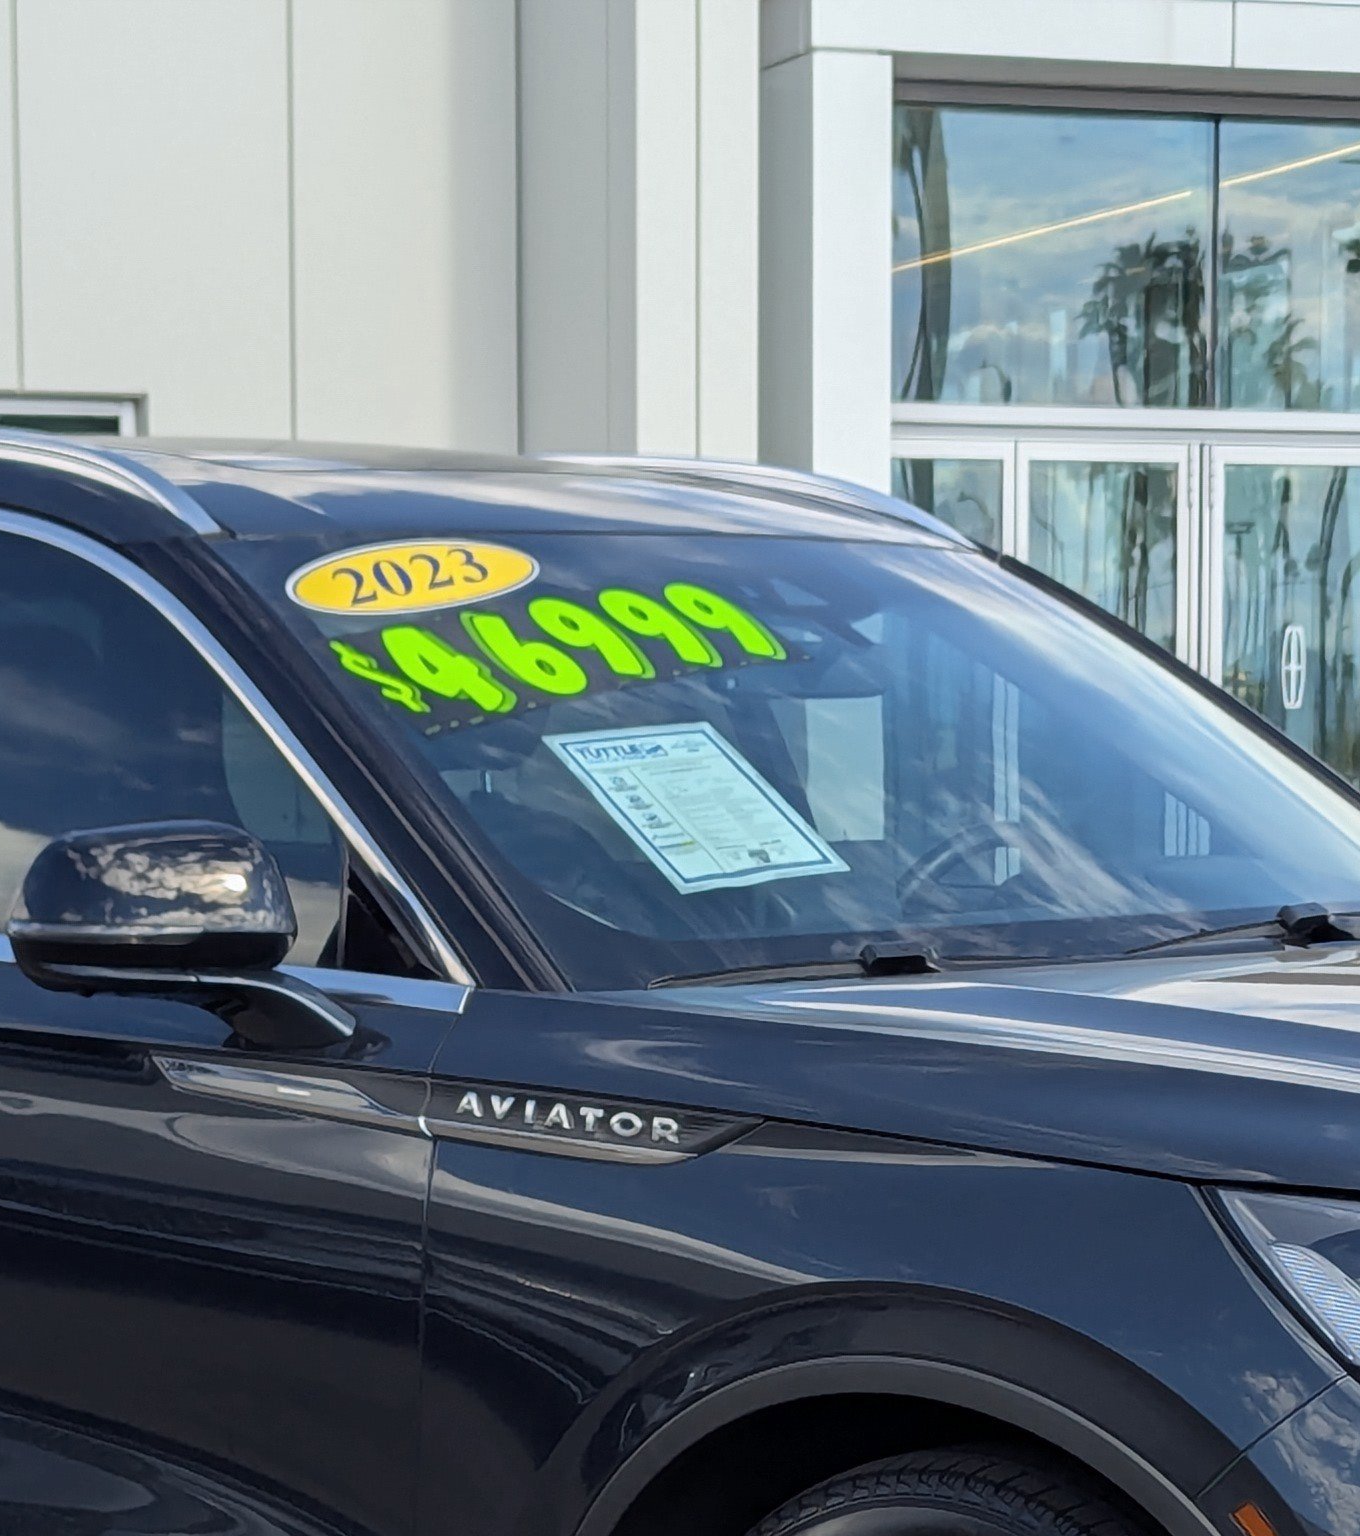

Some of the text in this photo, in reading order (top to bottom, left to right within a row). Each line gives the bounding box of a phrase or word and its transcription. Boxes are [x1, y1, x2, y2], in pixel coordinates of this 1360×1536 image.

[332, 548, 488, 607] 2023
[329, 582, 787, 714] $46999
[456, 1091, 680, 1144] AVIATOR
